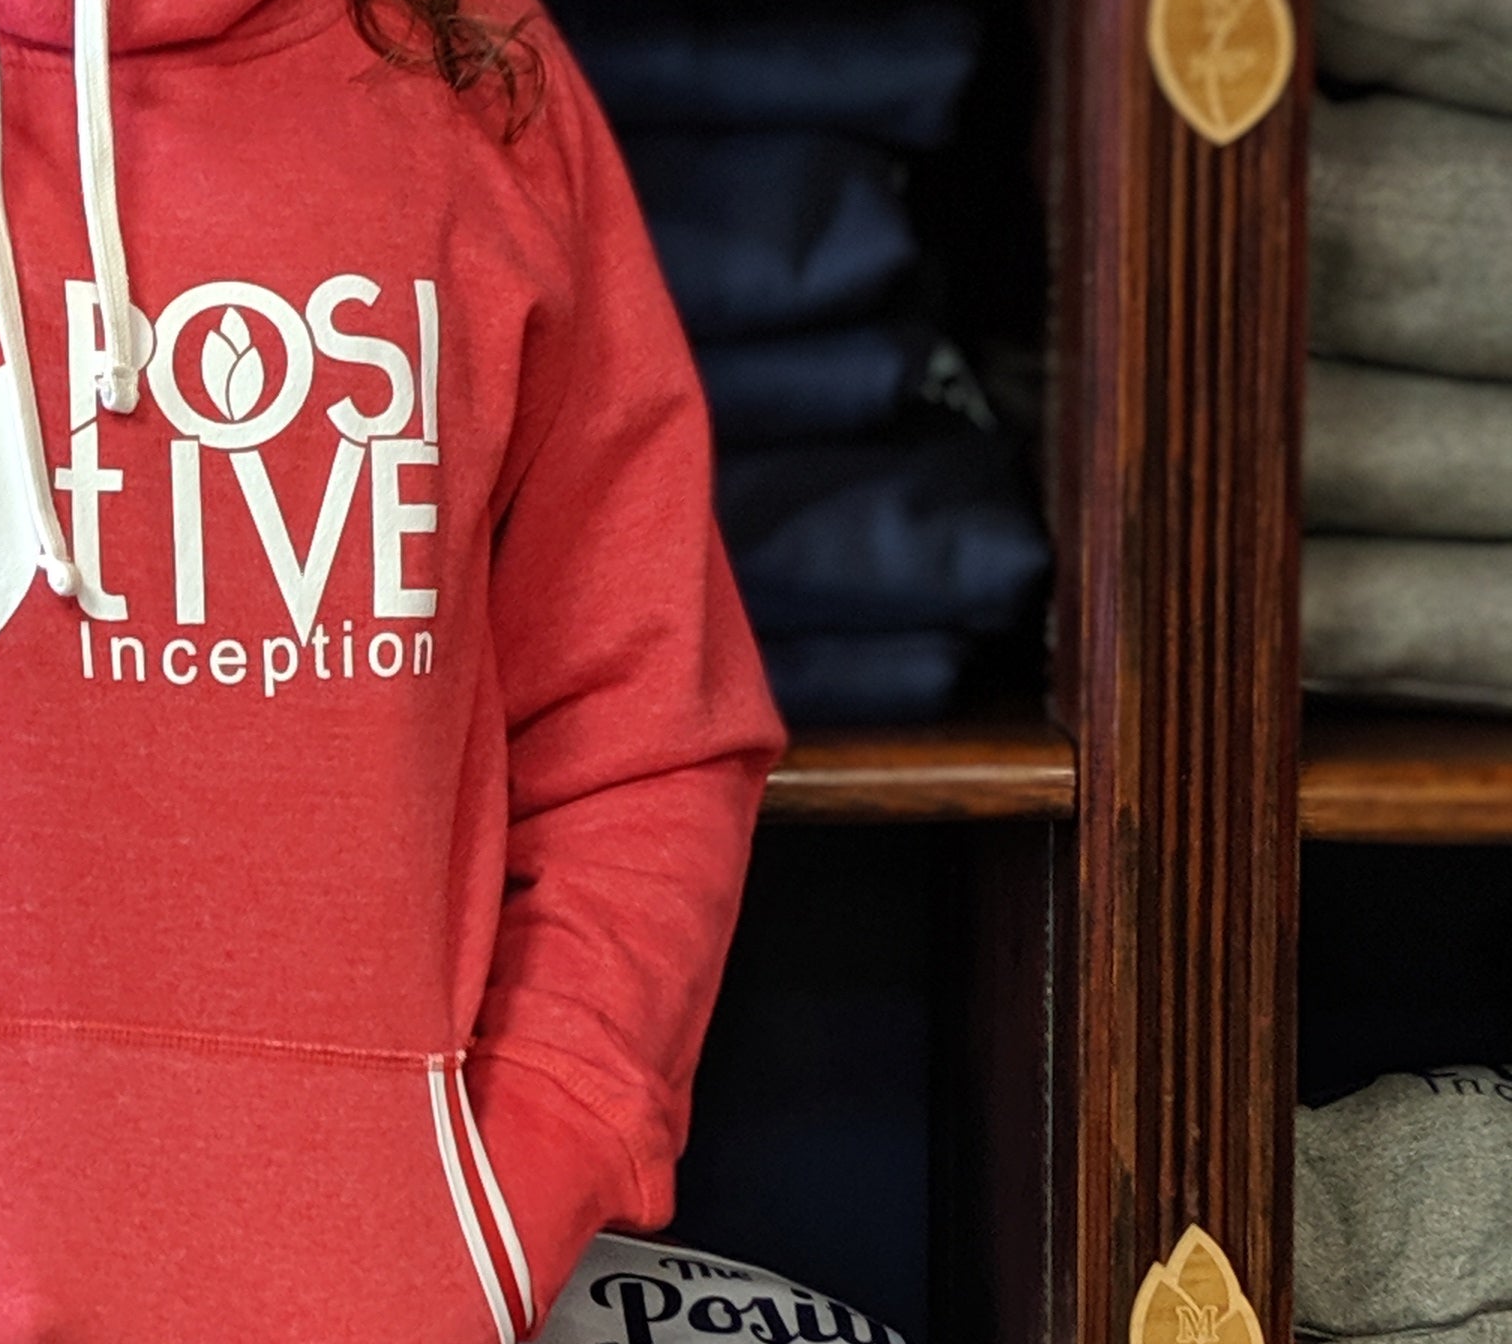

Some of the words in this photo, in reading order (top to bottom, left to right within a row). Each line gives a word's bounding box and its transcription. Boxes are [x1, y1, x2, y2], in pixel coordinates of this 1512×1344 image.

[65, 274, 439, 450] POSI
[80, 620, 434, 697] Inception
[1176, 1305, 1220, 1343] M
